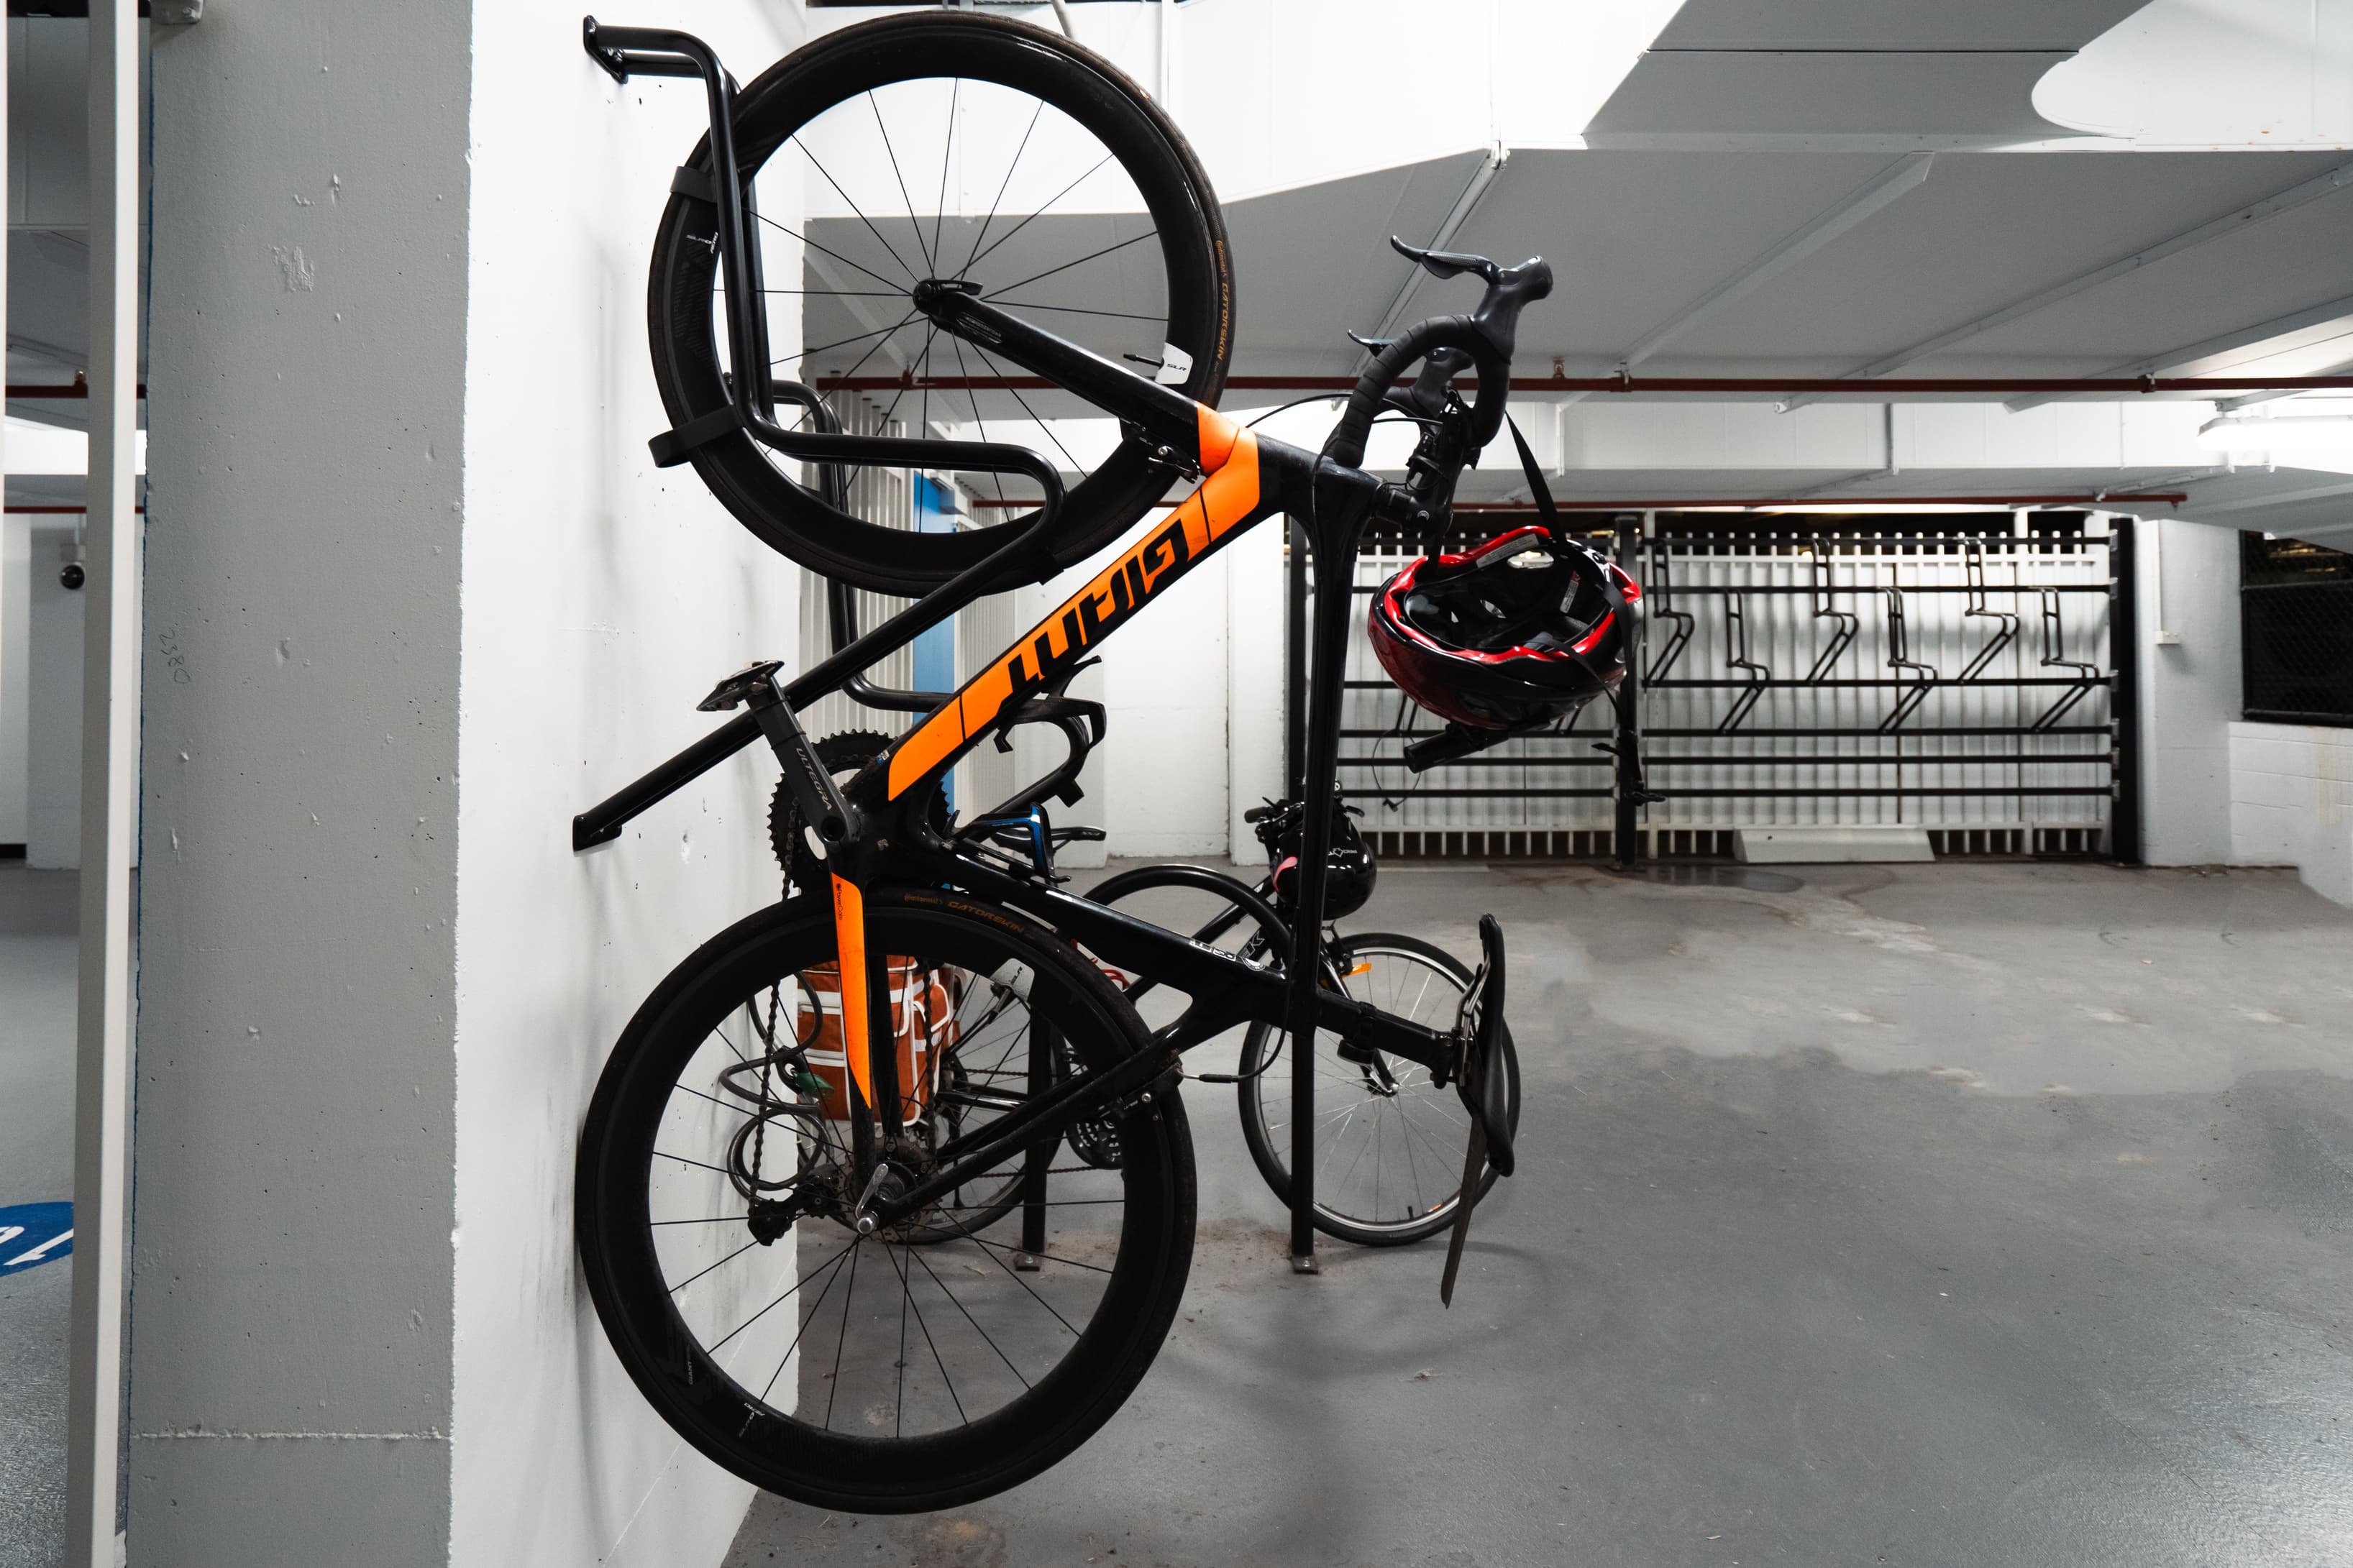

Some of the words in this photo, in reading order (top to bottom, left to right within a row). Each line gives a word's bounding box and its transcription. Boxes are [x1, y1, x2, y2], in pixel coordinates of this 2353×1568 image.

[1217, 283, 1228, 360] GATORSKIN
[1167, 363, 1187, 372] SLR
[1008, 518, 1190, 694] GIANT
[796, 748, 833, 811] ULTEGRA
[948, 901, 1024, 932] GATORSKIN
[1010, 966, 1023, 986] SLR
